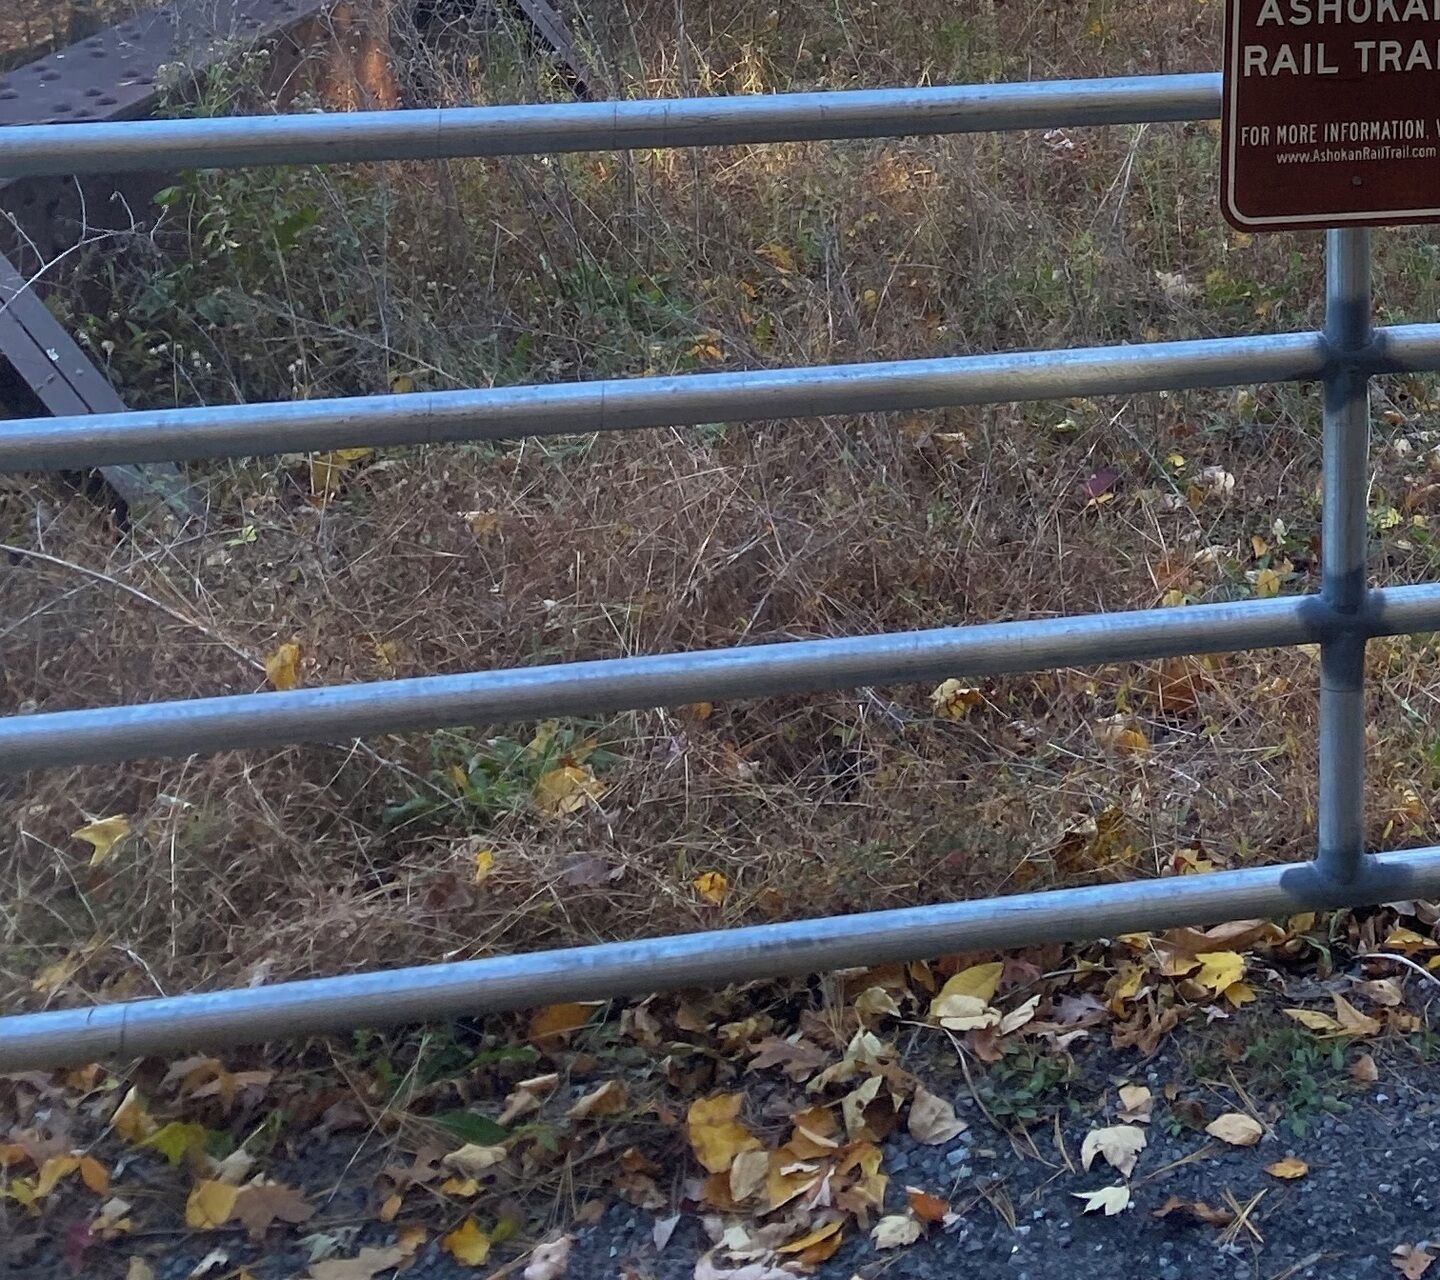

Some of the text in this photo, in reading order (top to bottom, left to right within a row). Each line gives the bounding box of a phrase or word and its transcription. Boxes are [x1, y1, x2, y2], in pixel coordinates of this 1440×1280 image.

[1244, 43, 1338, 76] RAIL
[1242, 126, 1269, 146] FOR
[1277, 124, 1317, 144] MORE
[1277, 145, 1436, 163] www.AshokanRailTrail.com
